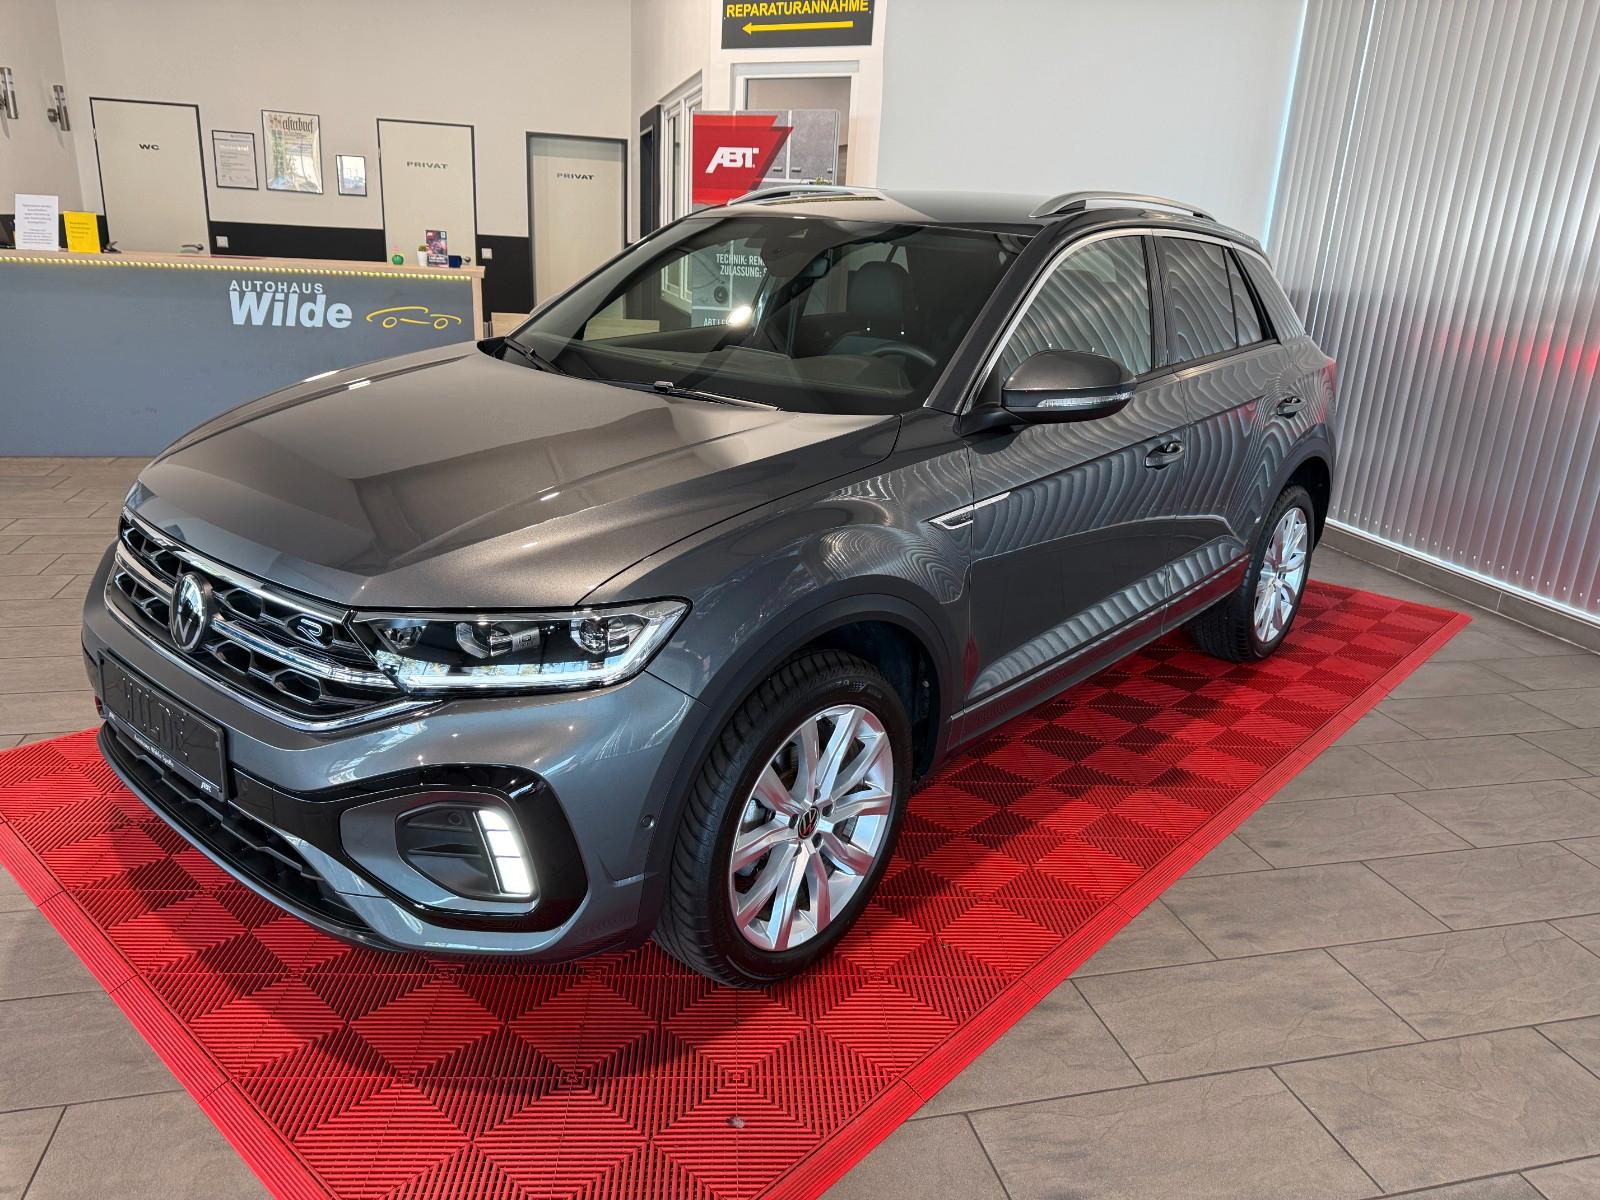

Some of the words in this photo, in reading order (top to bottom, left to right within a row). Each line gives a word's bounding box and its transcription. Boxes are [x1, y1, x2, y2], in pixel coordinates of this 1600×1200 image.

[726, 0, 869, 18] REPARATURANNAHME
[406, 160, 449, 169] PRIVAT
[556, 172, 595, 180] PRIVAT
[720, 265, 762, 278] ZULASSUNG:
[229, 279, 324, 294] AUTOHAUS
[229, 290, 353, 329] Wilde
